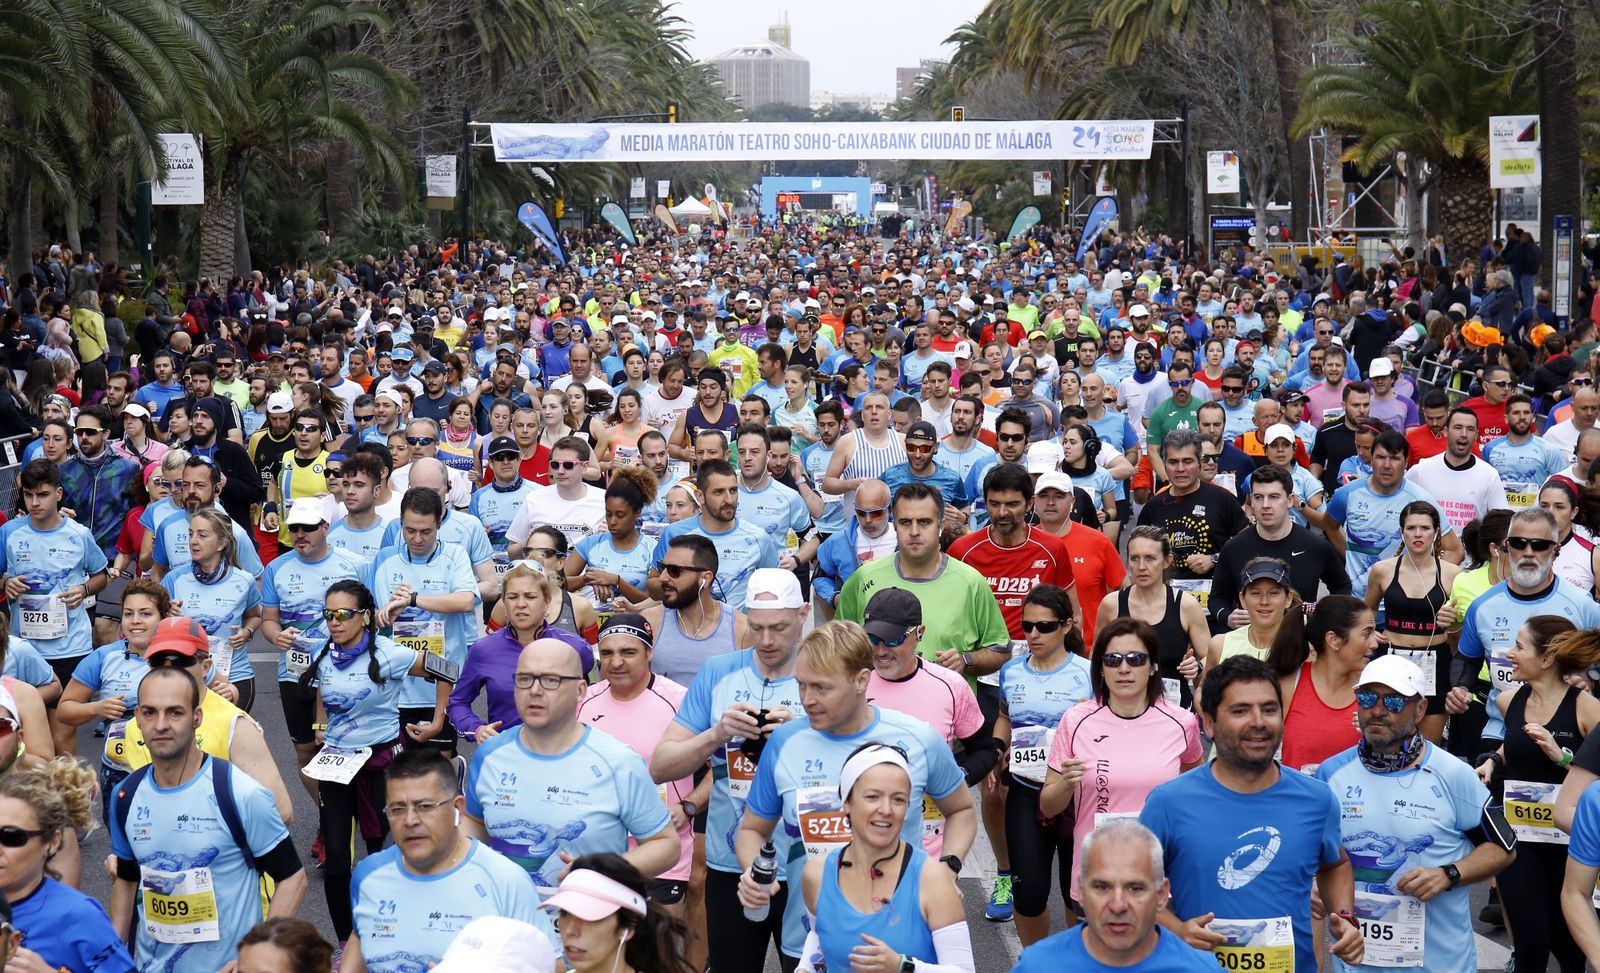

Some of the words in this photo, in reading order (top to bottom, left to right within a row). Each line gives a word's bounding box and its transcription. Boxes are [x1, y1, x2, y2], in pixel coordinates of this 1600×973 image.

[620, 134, 664, 151] MEDIA
[668, 131, 734, 150] MARATÓN
[738, 134, 790, 150] TEATRO
[794, 132, 916, 150] SOHO-CAIXABANK
[921, 133, 970, 150] CIUDAD
[975, 133, 992, 150] DE
[996, 129, 1052, 150] MÁLAGA
[1072, 126, 1100, 148] 24
[1484, 426, 1502, 435] edp
[998, 577, 1030, 592] D2B
[23, 612, 49, 622] 9278
[1495, 617, 1508, 627] 24
[734, 690, 751, 702] 24
[317, 755, 345, 766] 9570
[1015, 749, 1046, 764] 9454
[805, 759, 823, 773] 24
[501, 772, 517, 786] 24
[1346, 785, 1362, 798] 24
[1394, 800, 1406, 808] edp
[137, 806, 150, 820] 24
[1515, 806, 1552, 821] 6162
[808, 817, 852, 834] 5279
[152, 898, 189, 916] 6059
[378, 900, 396, 915] 24
[429, 911, 441, 920] edp
[1361, 922, 1393, 940] 195
[1215, 952, 1266, 970] 6058
